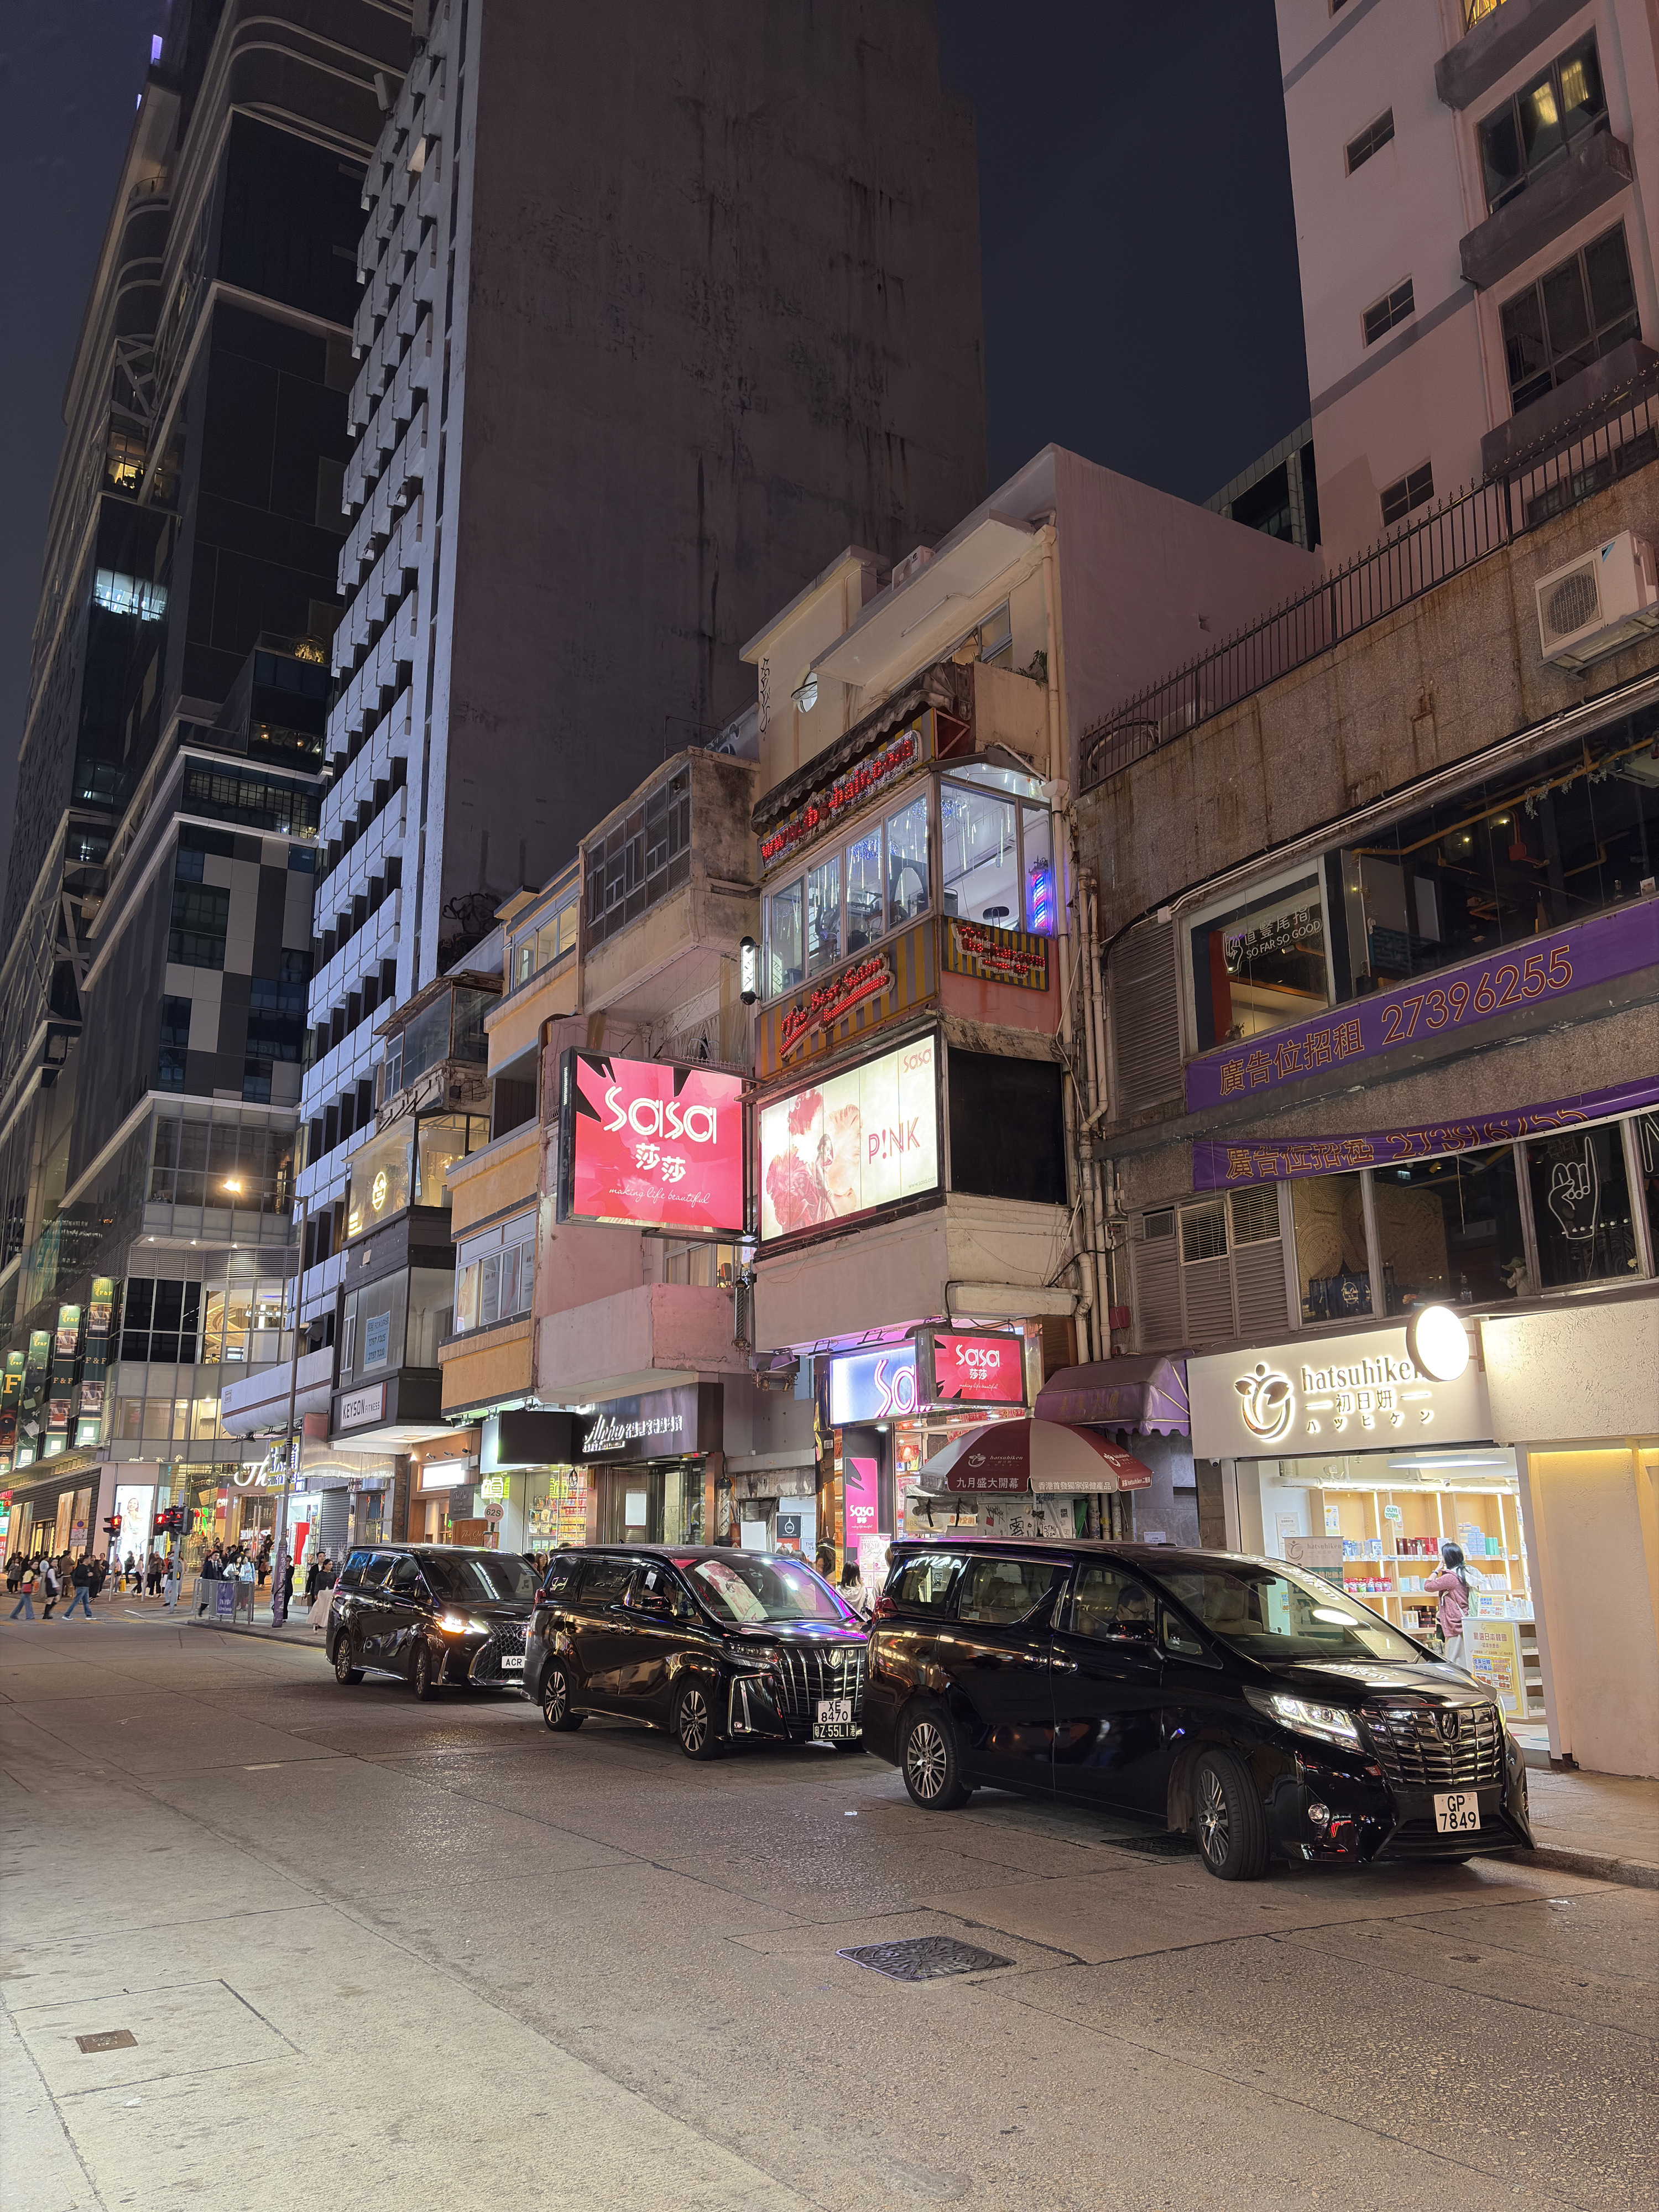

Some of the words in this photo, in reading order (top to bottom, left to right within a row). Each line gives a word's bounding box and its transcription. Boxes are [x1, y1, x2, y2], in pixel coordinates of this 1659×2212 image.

[1246, 947, 1259, 959] SO
[1260, 940, 1275, 953] FAR
[1276, 934, 1290, 946] SO
[1292, 921, 1321, 938] GOOD
[1219, 1018, 1364, 1096] 廣告位招租
[1382, 945, 1573, 1045] 27396255
[635, 1142, 686, 1183] 莎莎
[908, 1176, 936, 1189] www.sasa.com
[609, 1184, 645, 1202] making
[646, 1187, 665, 1203] life
[668, 1190, 711, 1208] beautiful
[969, 1368, 988, 1380] 莎莎
[343, 1399, 365, 1420] KEYSON
[365, 1401, 380, 1413] FITNESS
[956, 1477, 1019, 1489] 九月盛大開幕
[1037, 1481, 1112, 1491] 香港首發獨家保健產品
[486, 1509, 501, 1517] 62S
[505, 1658, 522, 1666] ACR
[828, 1701, 842, 1712] XE
[821, 1710, 848, 1723] 8470
[1447, 1795, 1465, 1813] GP
[1439, 1811, 1477, 1830] 7849
